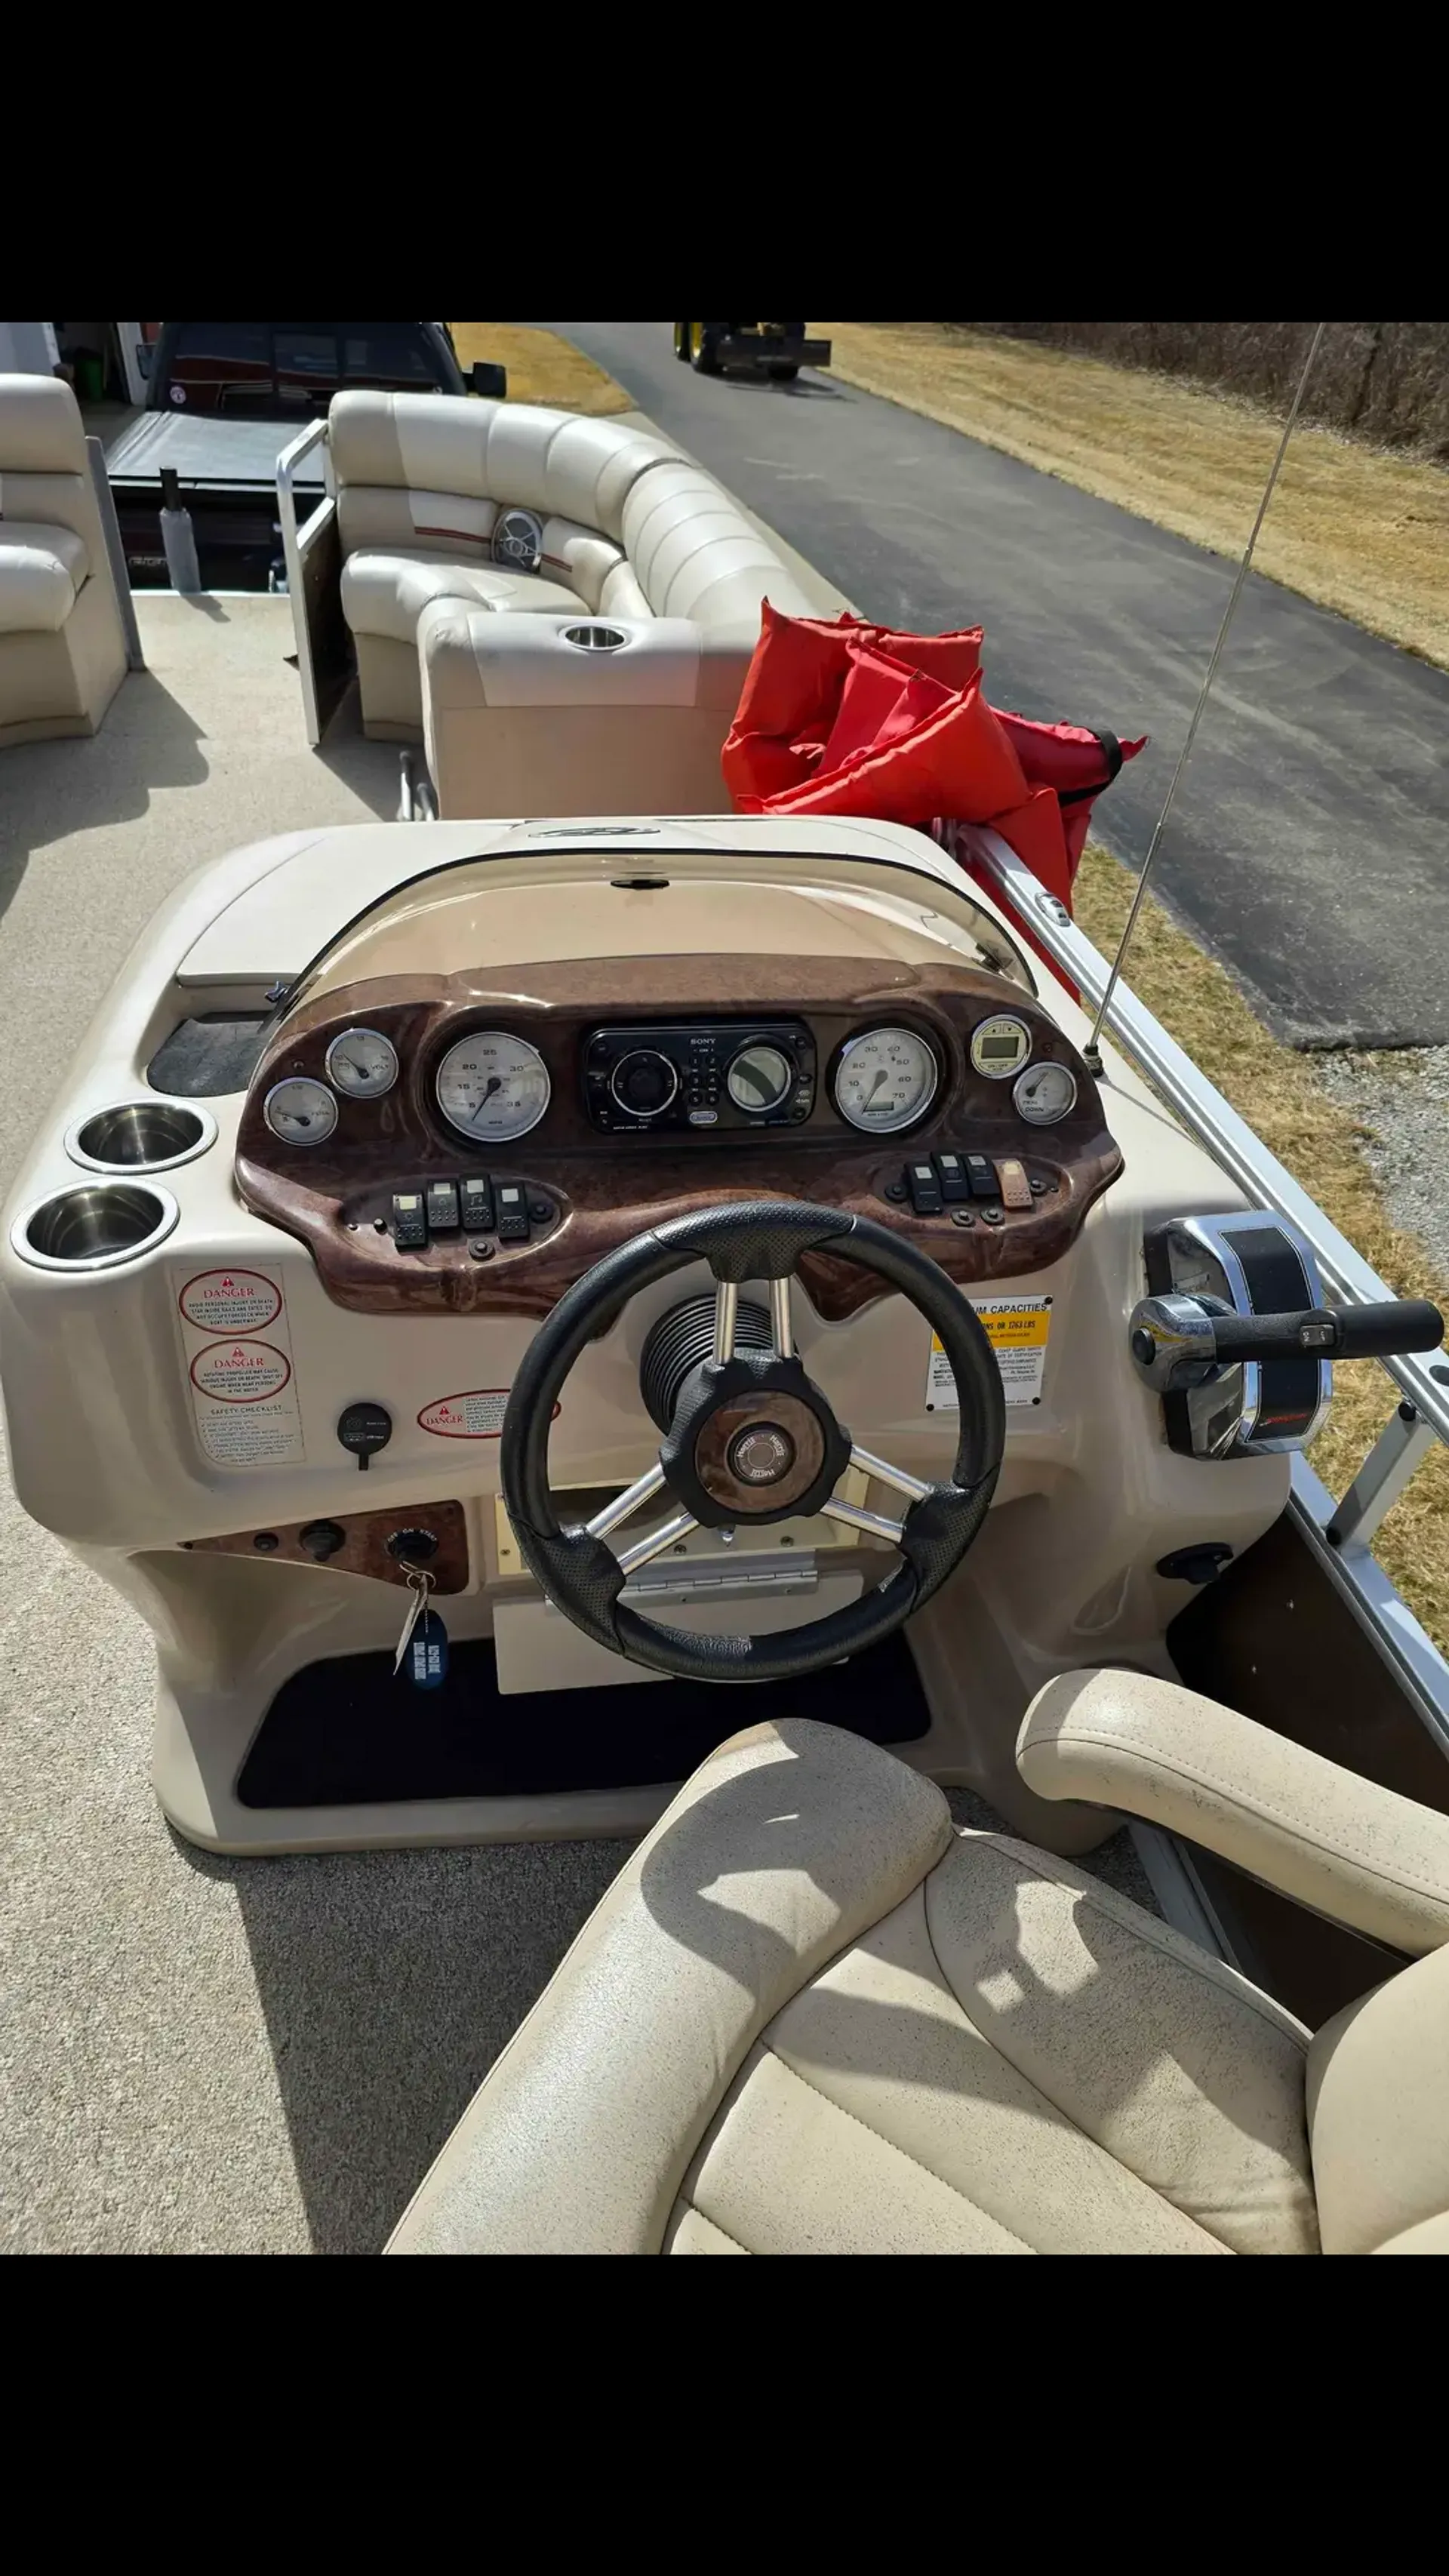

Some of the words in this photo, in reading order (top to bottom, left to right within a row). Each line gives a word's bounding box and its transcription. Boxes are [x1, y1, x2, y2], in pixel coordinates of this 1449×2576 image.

[203, 1288, 254, 1299] DANGER
[990, 1303, 1048, 1314] CAPACITIES
[214, 1358, 264, 1368] DANGER
[211, 1408, 238, 1416] SAFETY
[240, 1405, 282, 1413] CHECKLIST
[426, 1415, 463, 1426] DANGER
